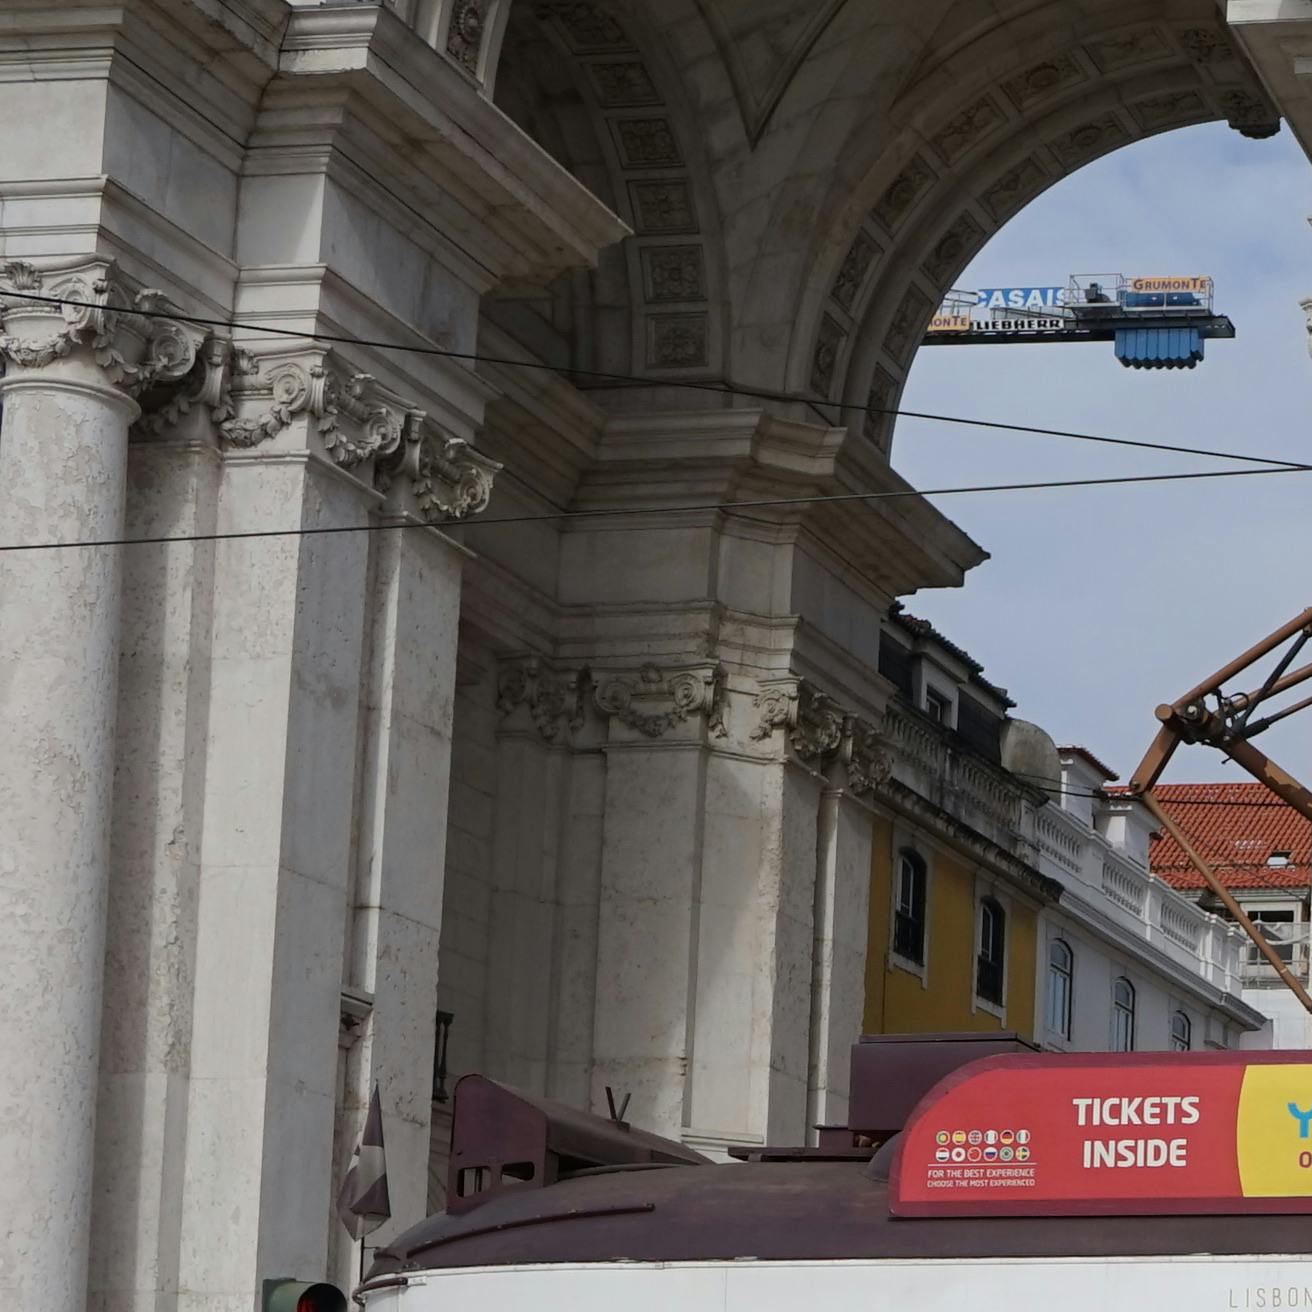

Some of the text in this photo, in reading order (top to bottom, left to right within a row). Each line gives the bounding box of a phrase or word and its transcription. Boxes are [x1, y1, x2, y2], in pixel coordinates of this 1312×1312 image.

[1133, 278, 1206, 290] GRUMONTE
[977, 319, 1061, 330] LIEBHERR
[1073, 1095, 1200, 1127] TICKETS
[1083, 1138, 1187, 1169] INSIDE
[928, 1168, 1035, 1178] FOR THE BEST EXPERIENCE
[927, 1180, 954, 1188] CHOOSE
[970, 1179, 988, 1187] MOST
[990, 1179, 1035, 1187] EXPERIENCED
